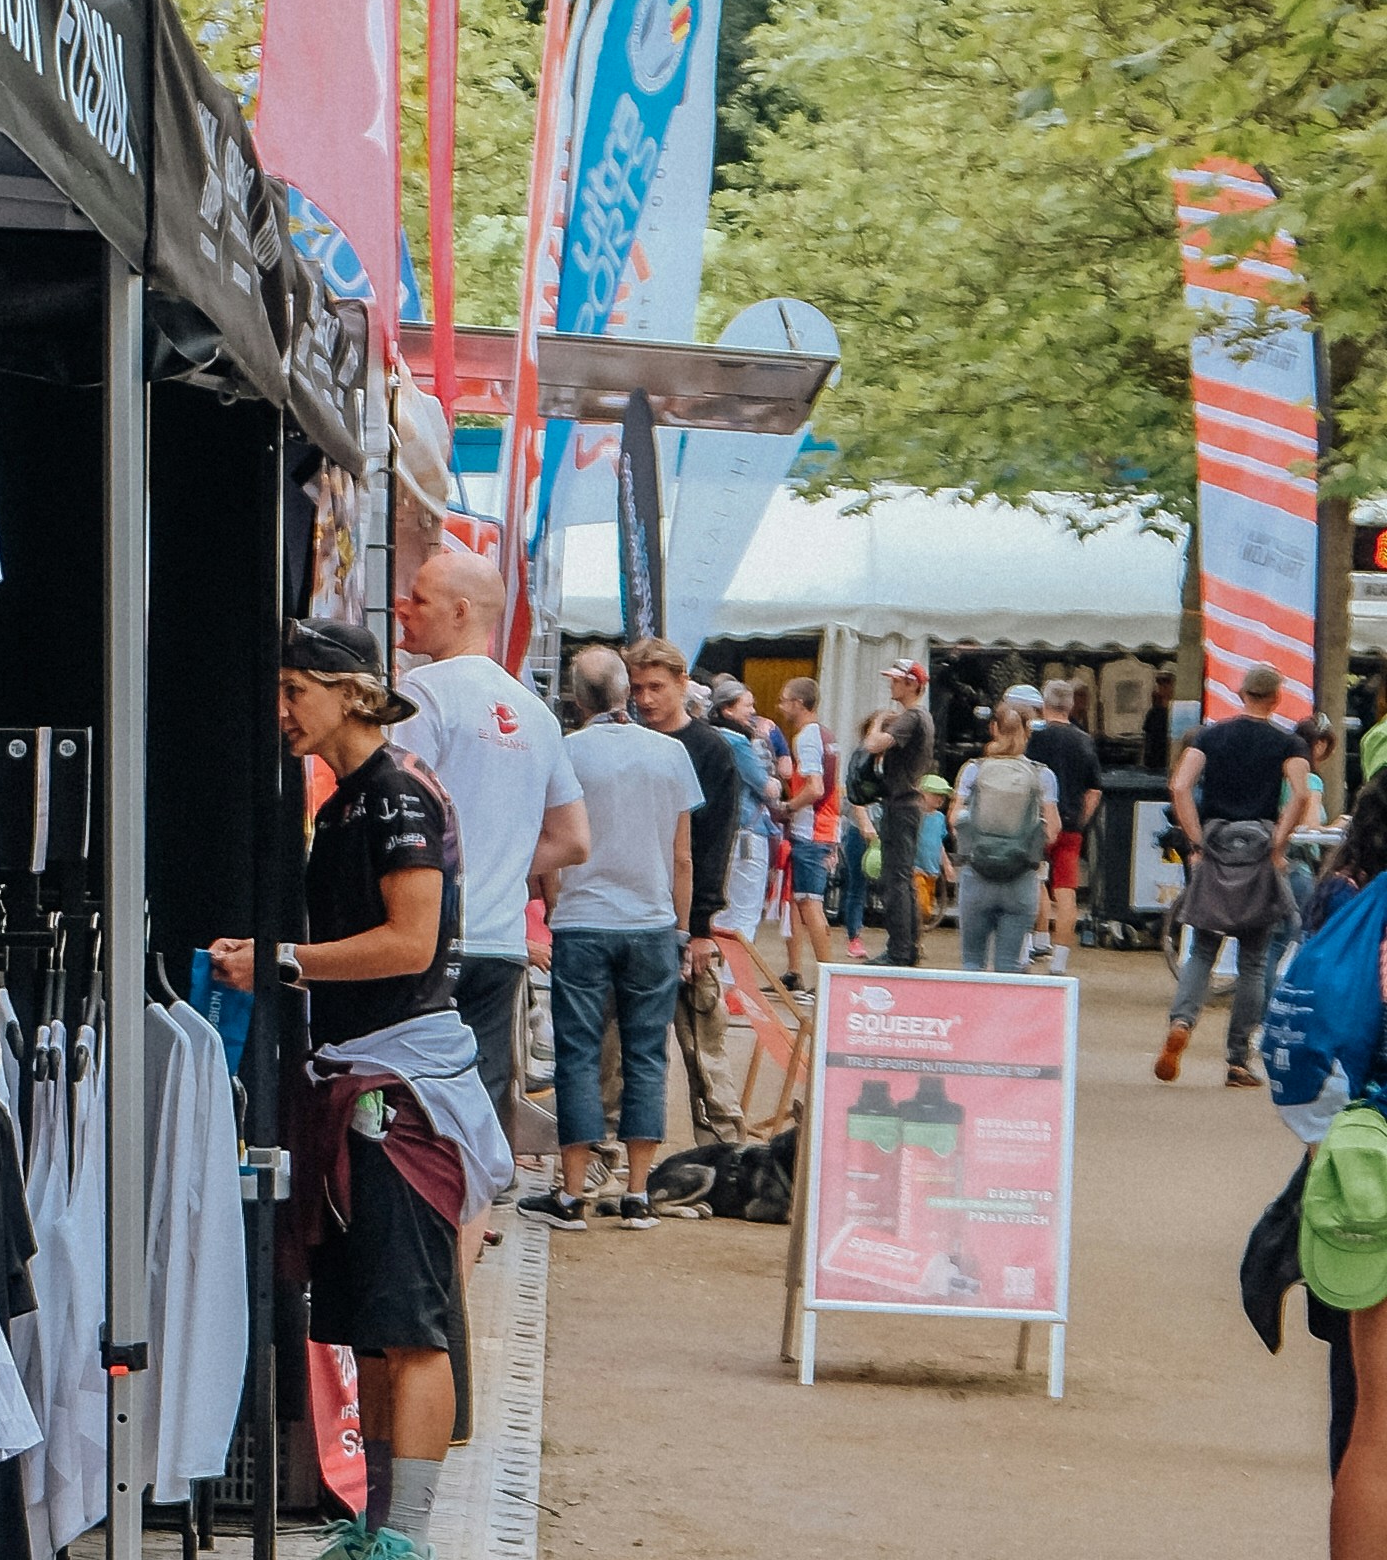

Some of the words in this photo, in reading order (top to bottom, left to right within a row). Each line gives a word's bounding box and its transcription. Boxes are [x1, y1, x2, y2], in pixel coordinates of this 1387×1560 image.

[847, 1012, 954, 1037] SQUEEZY
[847, 1034, 893, 1048] SPORTS
[894, 1038, 954, 1052] NUTRITION
[845, 1055, 875, 1069] TRUE
[876, 1057, 920, 1071] SPORTS
[921, 1061, 978, 1075] NUTRITION
[968, 1210, 1050, 1226] PRAKTISCH
